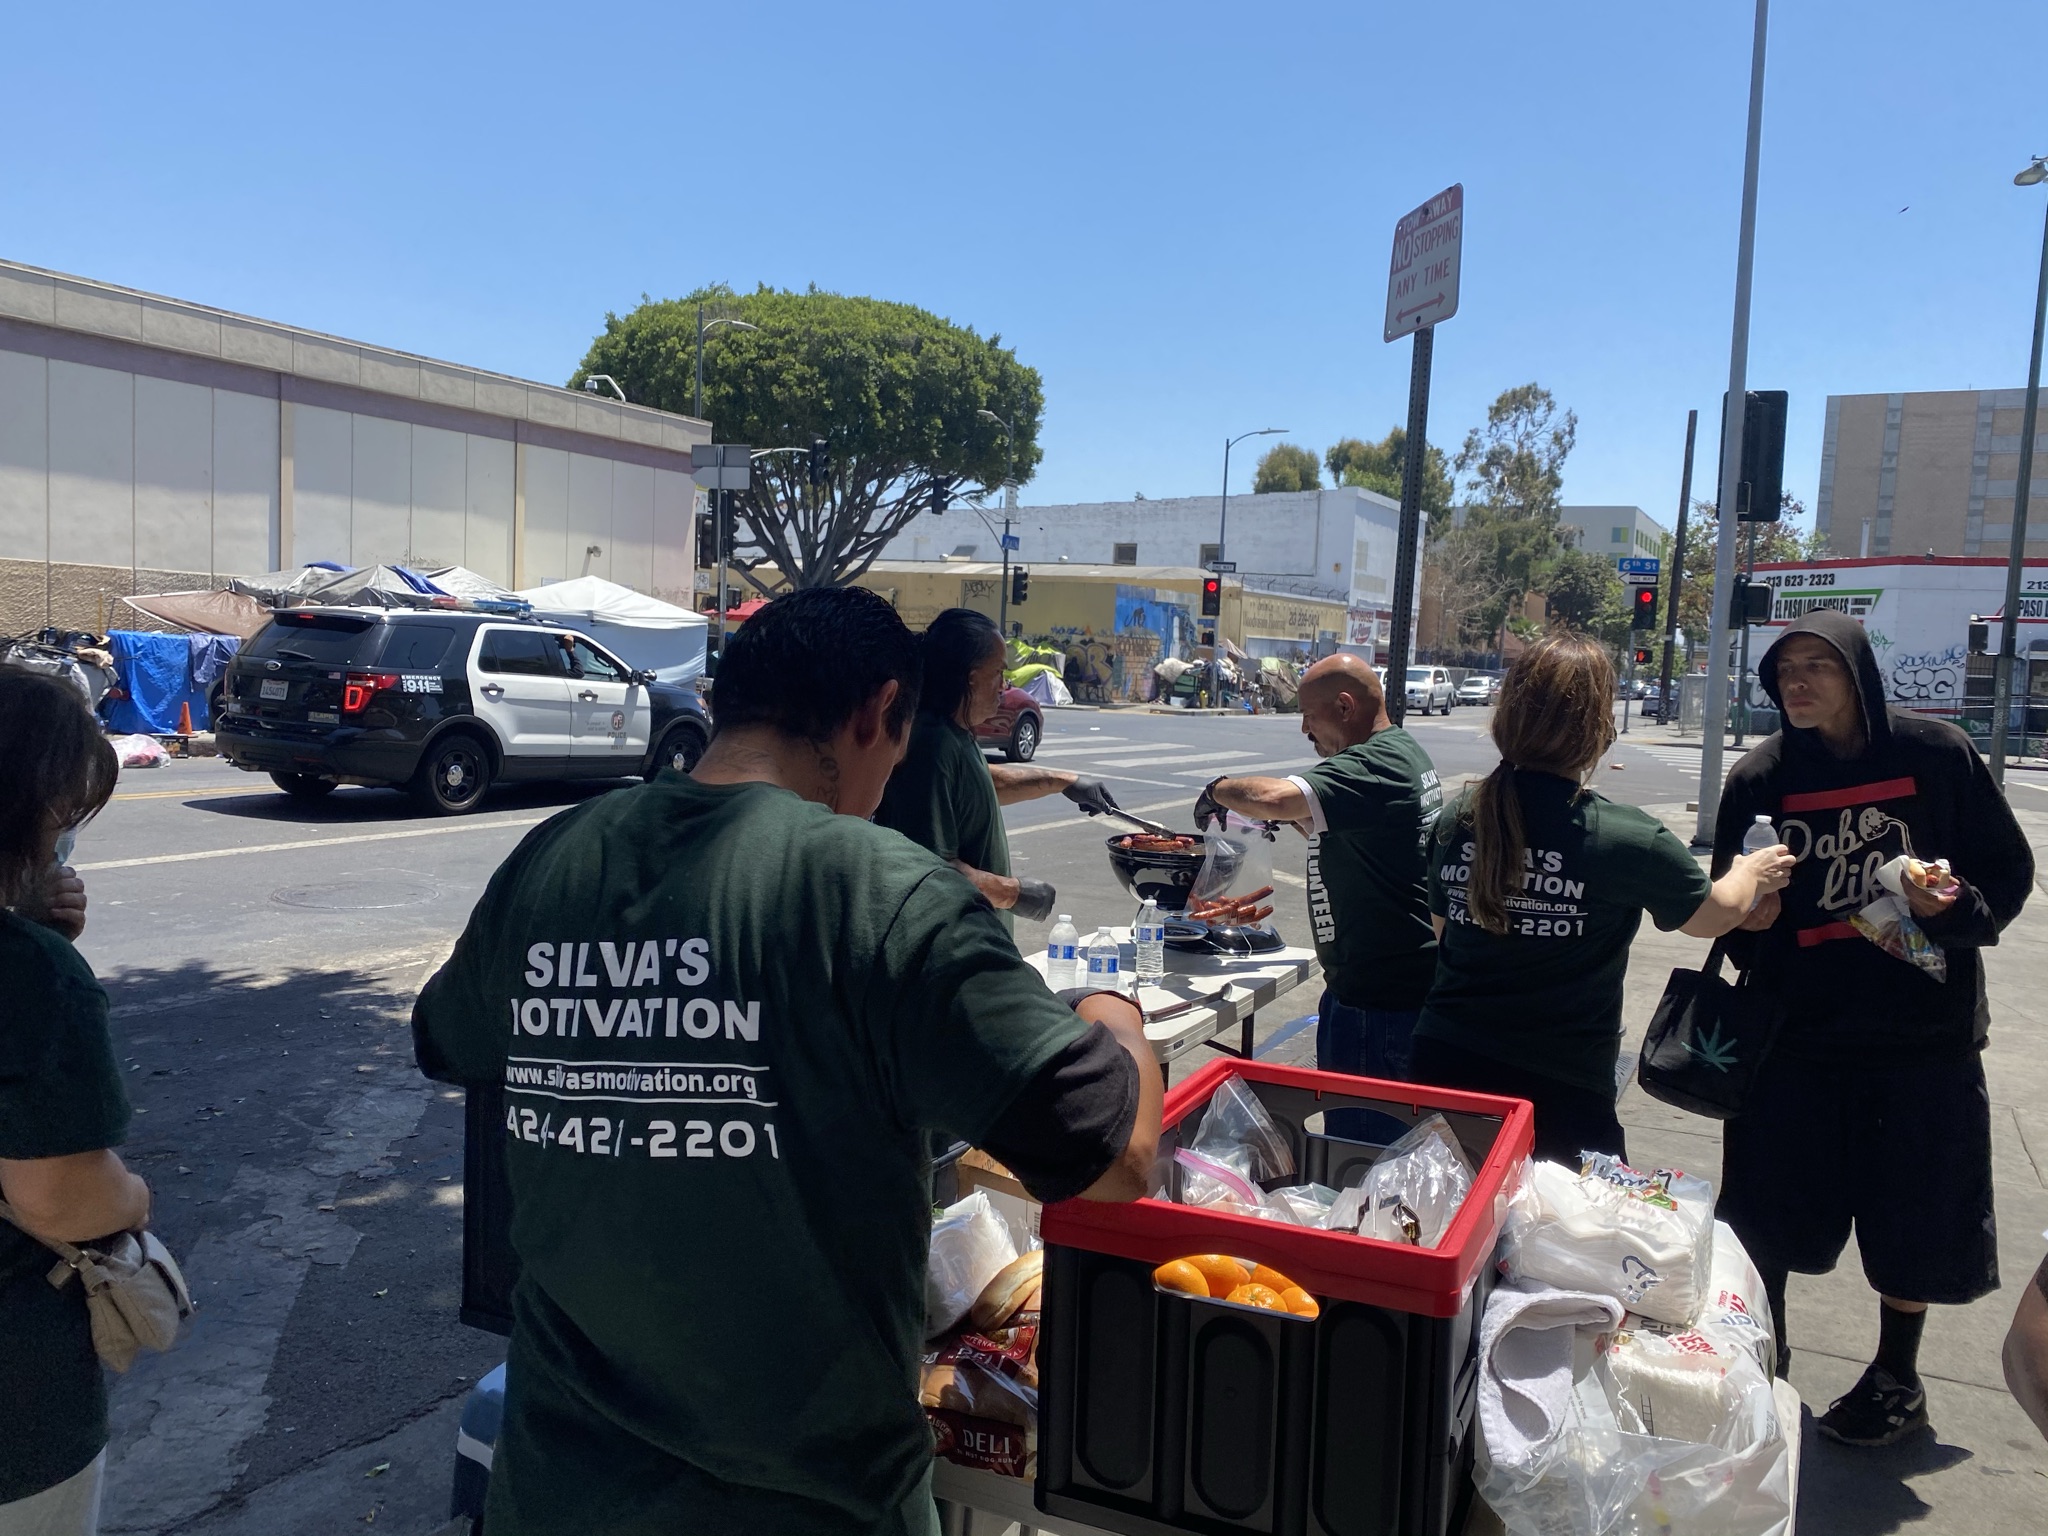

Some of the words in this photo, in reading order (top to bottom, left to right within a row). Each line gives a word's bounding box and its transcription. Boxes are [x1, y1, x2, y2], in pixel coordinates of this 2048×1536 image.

[1393, 234, 1412, 271] NO
[1413, 215, 1459, 259] STOPPING
[1395, 274, 1418, 300] ANY
[1424, 257, 1450, 287] TIME
[1622, 560, 1641, 570] 6th
[1644, 562, 1657, 570] St
[1784, 573, 1835, 587] 623-2323
[1774, 599, 1782, 619] EL
[1784, 599, 1803, 619] PASO
[2019, 600, 2044, 617] PASO
[1460, 841, 1563, 873] SA'S
[1307, 833, 1336, 944] OLUNTEER
[1440, 865, 1585, 900] MOTION
[524, 937, 710, 988] SILVA'S
[962, 1429, 1010, 1455] DELI
